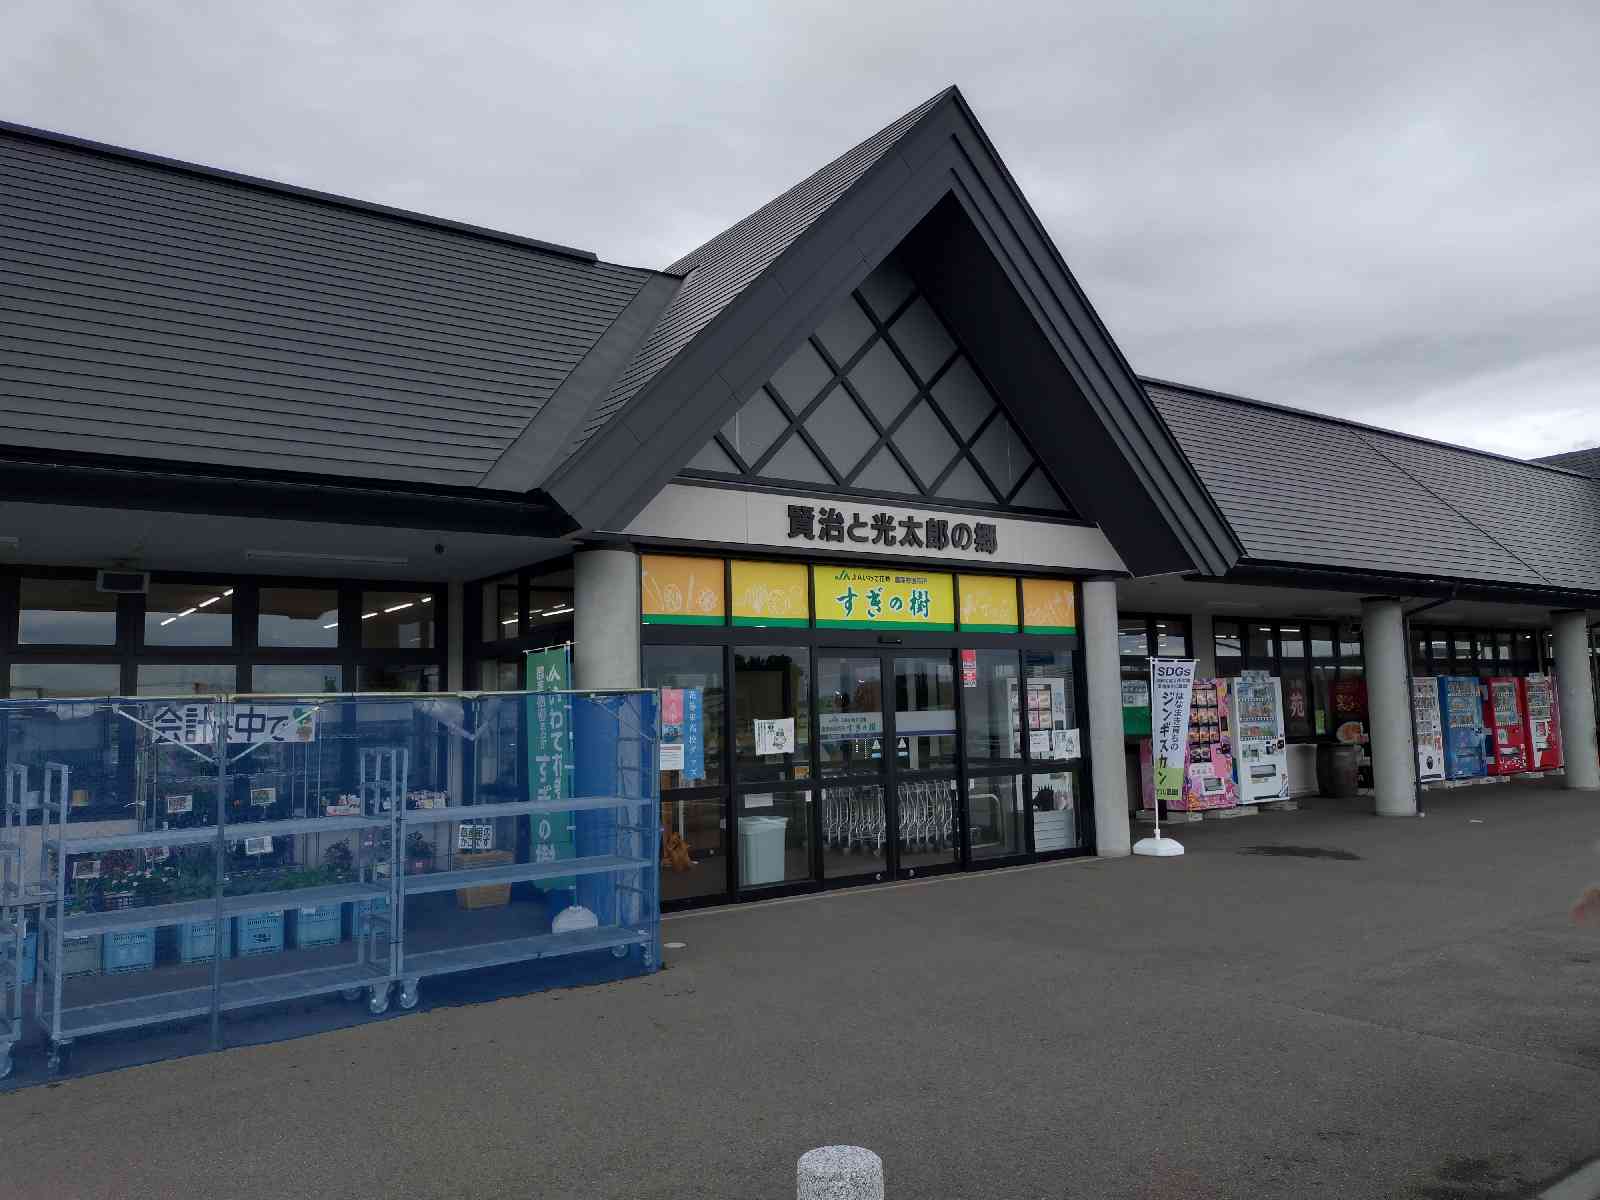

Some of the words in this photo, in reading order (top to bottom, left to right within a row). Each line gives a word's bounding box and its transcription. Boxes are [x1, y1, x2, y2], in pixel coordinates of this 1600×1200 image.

[787, 504, 998, 555] 賢治と光太郎の郷
[837, 586, 931, 618] すぎの樹
[1158, 666, 1191, 677] SDGs
[1158, 692, 1175, 785] ジンギスカン
